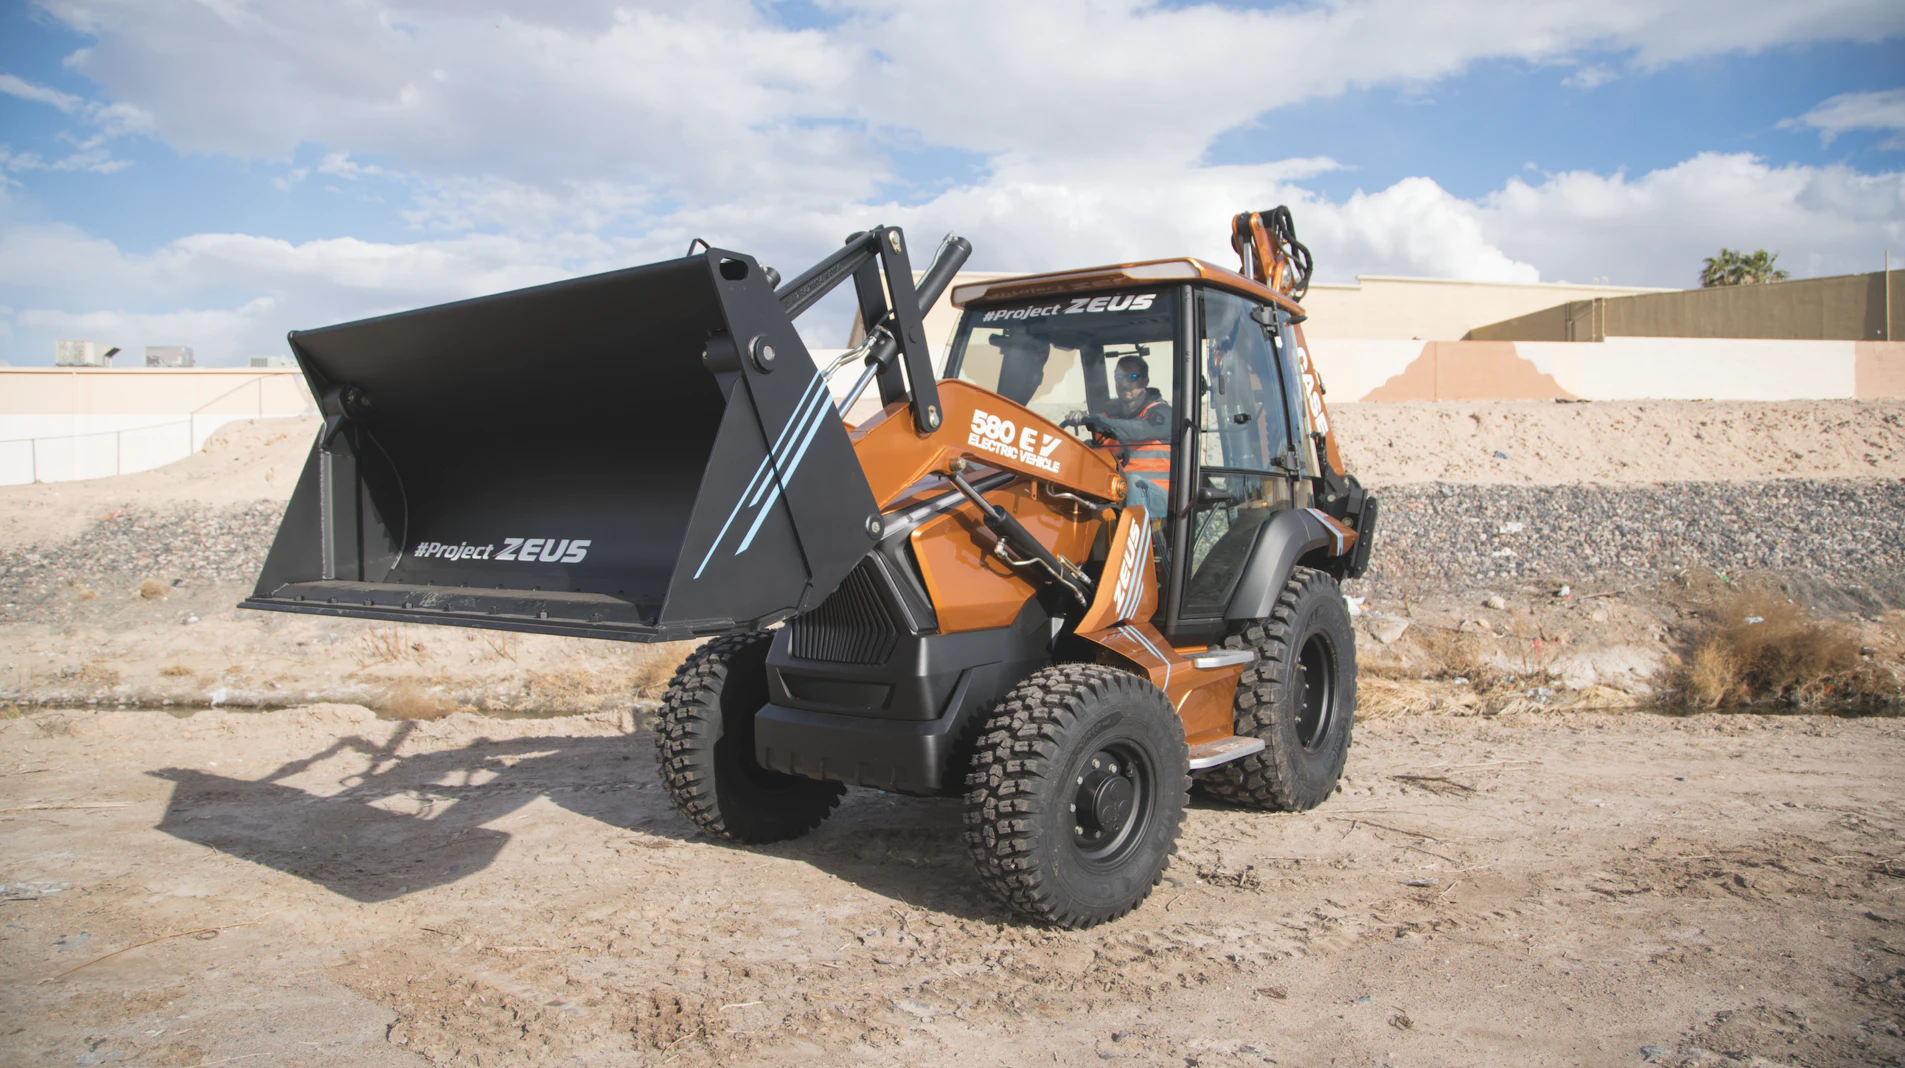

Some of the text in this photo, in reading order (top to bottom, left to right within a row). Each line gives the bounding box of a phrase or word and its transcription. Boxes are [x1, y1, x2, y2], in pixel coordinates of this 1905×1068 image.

[982, 293, 1157, 322] #Project ZEUS
[1297, 346, 1329, 436] CASE
[970, 408, 1016, 445] 580
[967, 432, 1061, 474] ELECTRIC VEHICLE
[413, 537, 592, 563] #Project ZEUS
[1113, 517, 1141, 616] ZEUS
